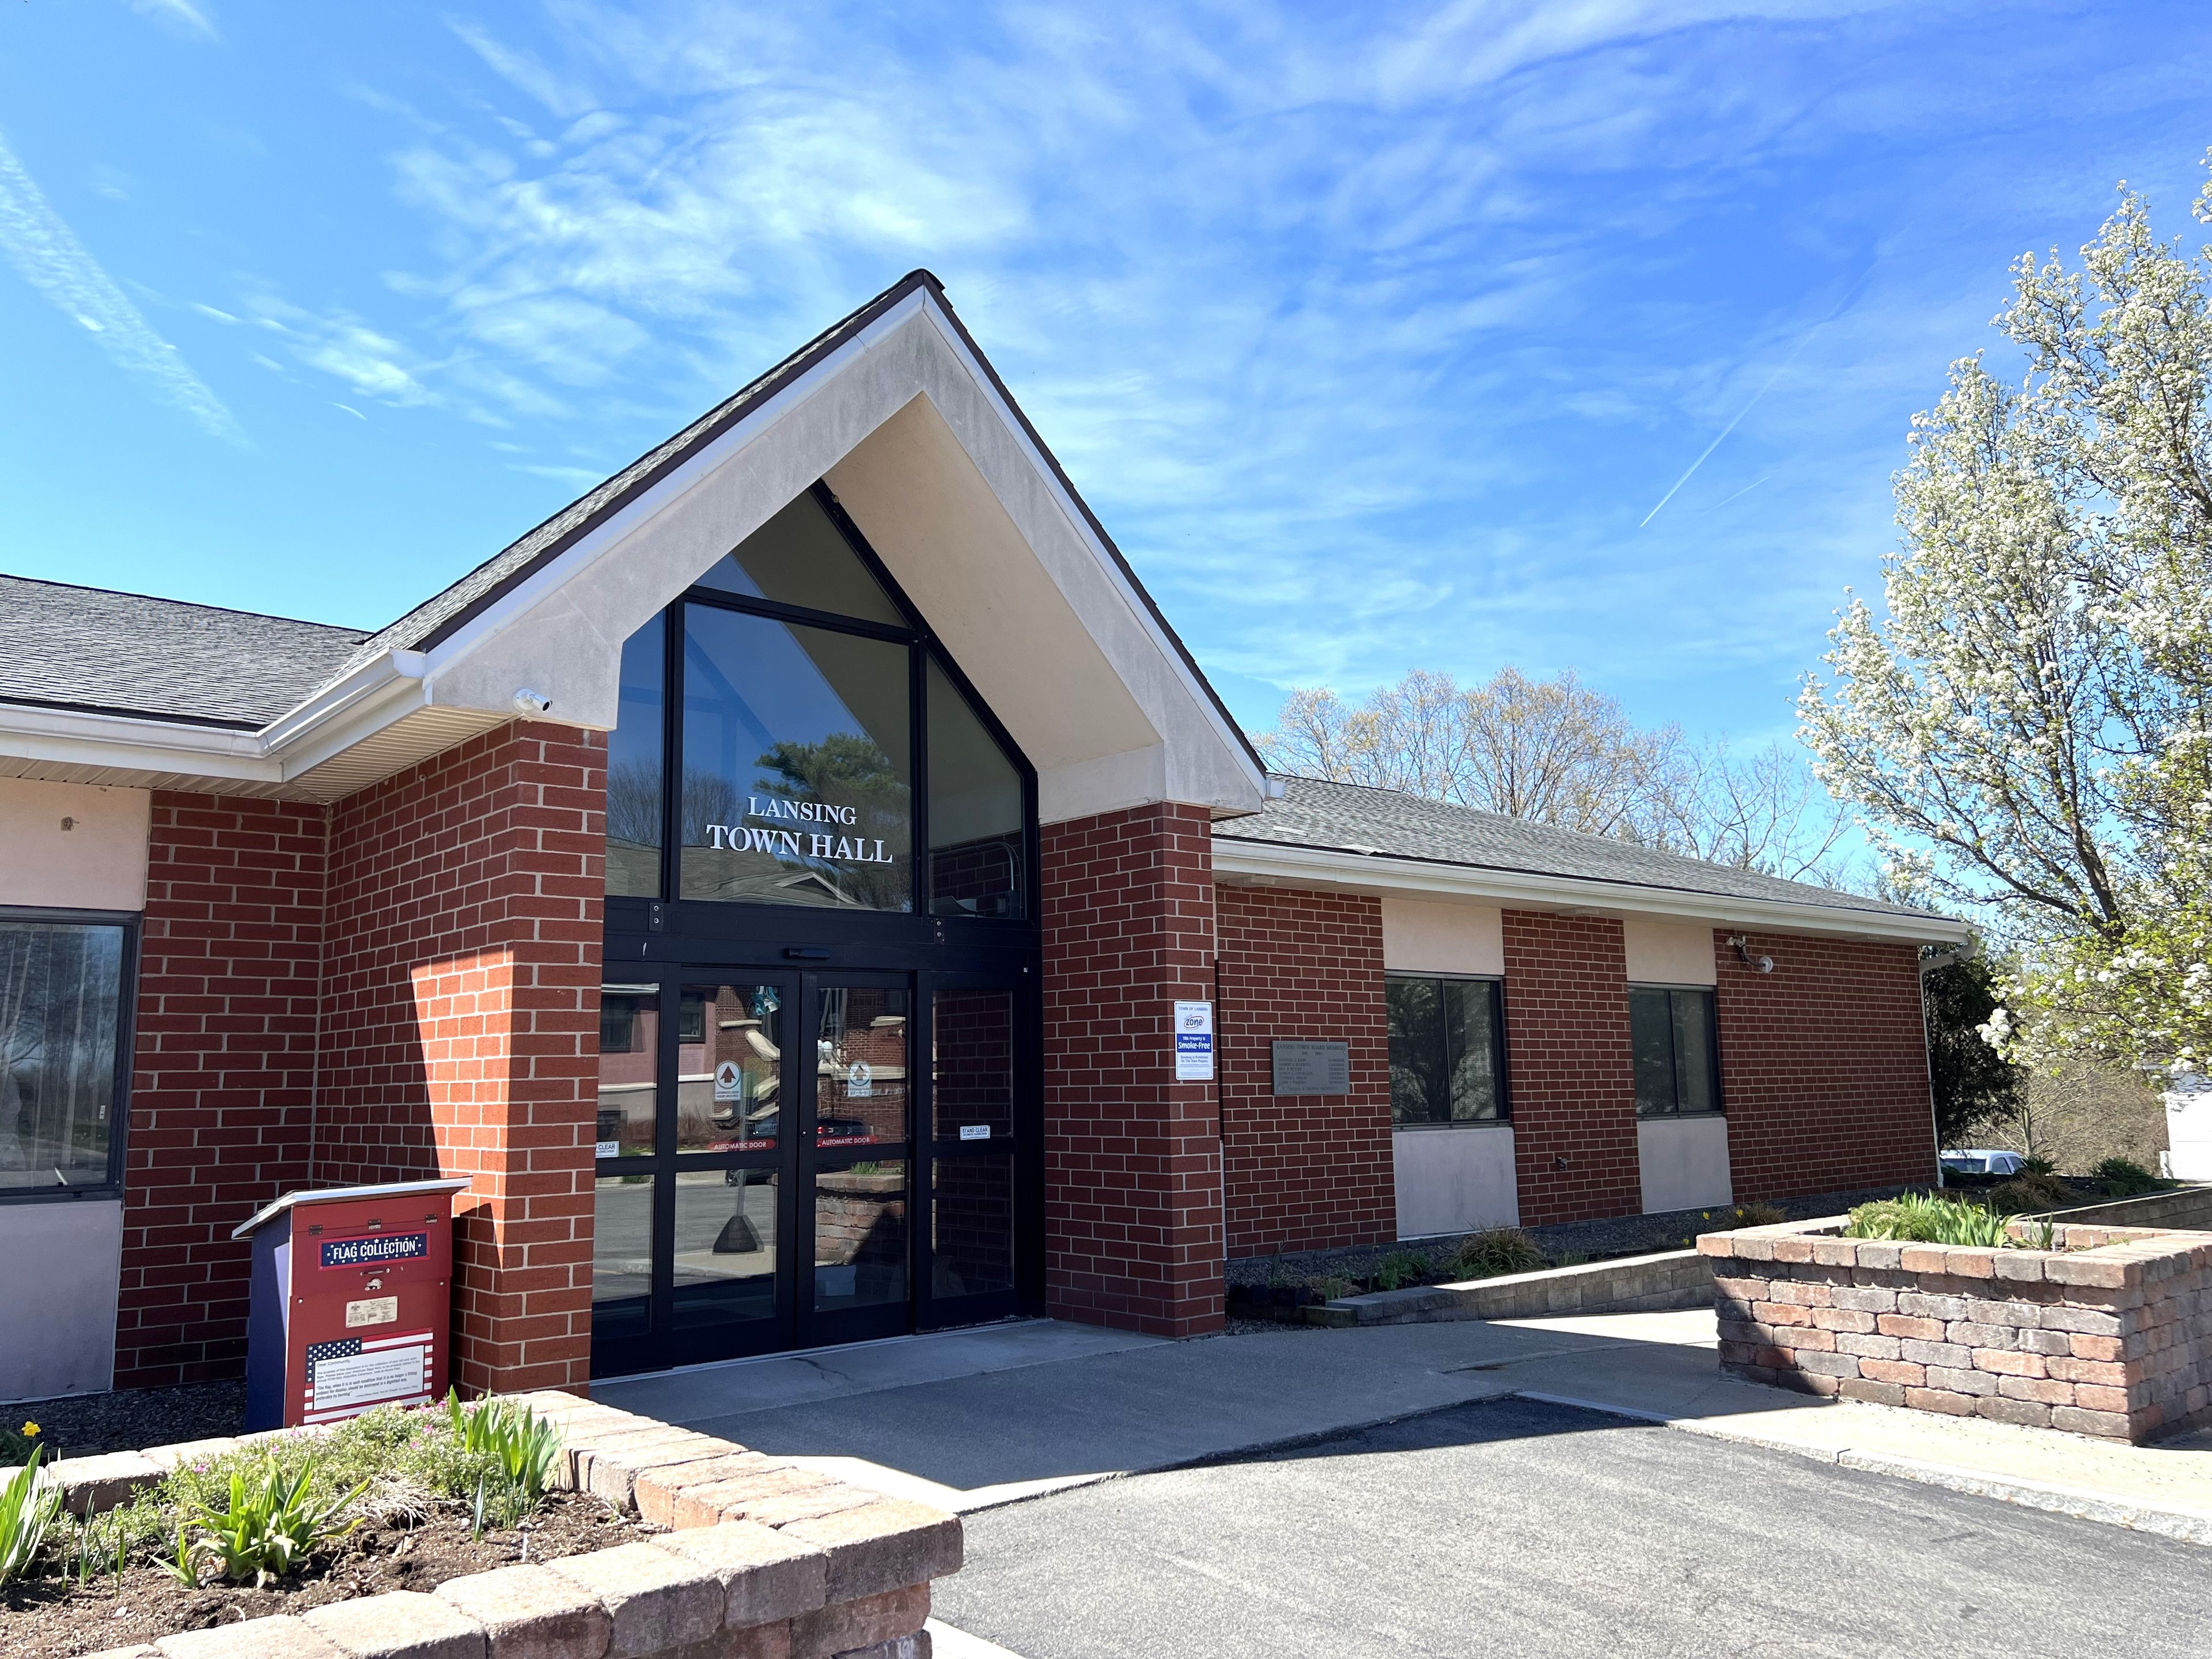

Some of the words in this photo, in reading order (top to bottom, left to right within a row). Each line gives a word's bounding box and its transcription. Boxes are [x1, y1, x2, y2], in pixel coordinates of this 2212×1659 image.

[748, 797, 857, 825] LANSING
[706, 824, 802, 855] TOWN
[809, 834, 893, 863] HALL
[1178, 1041, 1210, 1049] Smoke-Free
[334, 1246, 357, 1260] FLAG
[360, 1240, 415, 1256] COLLECTION
